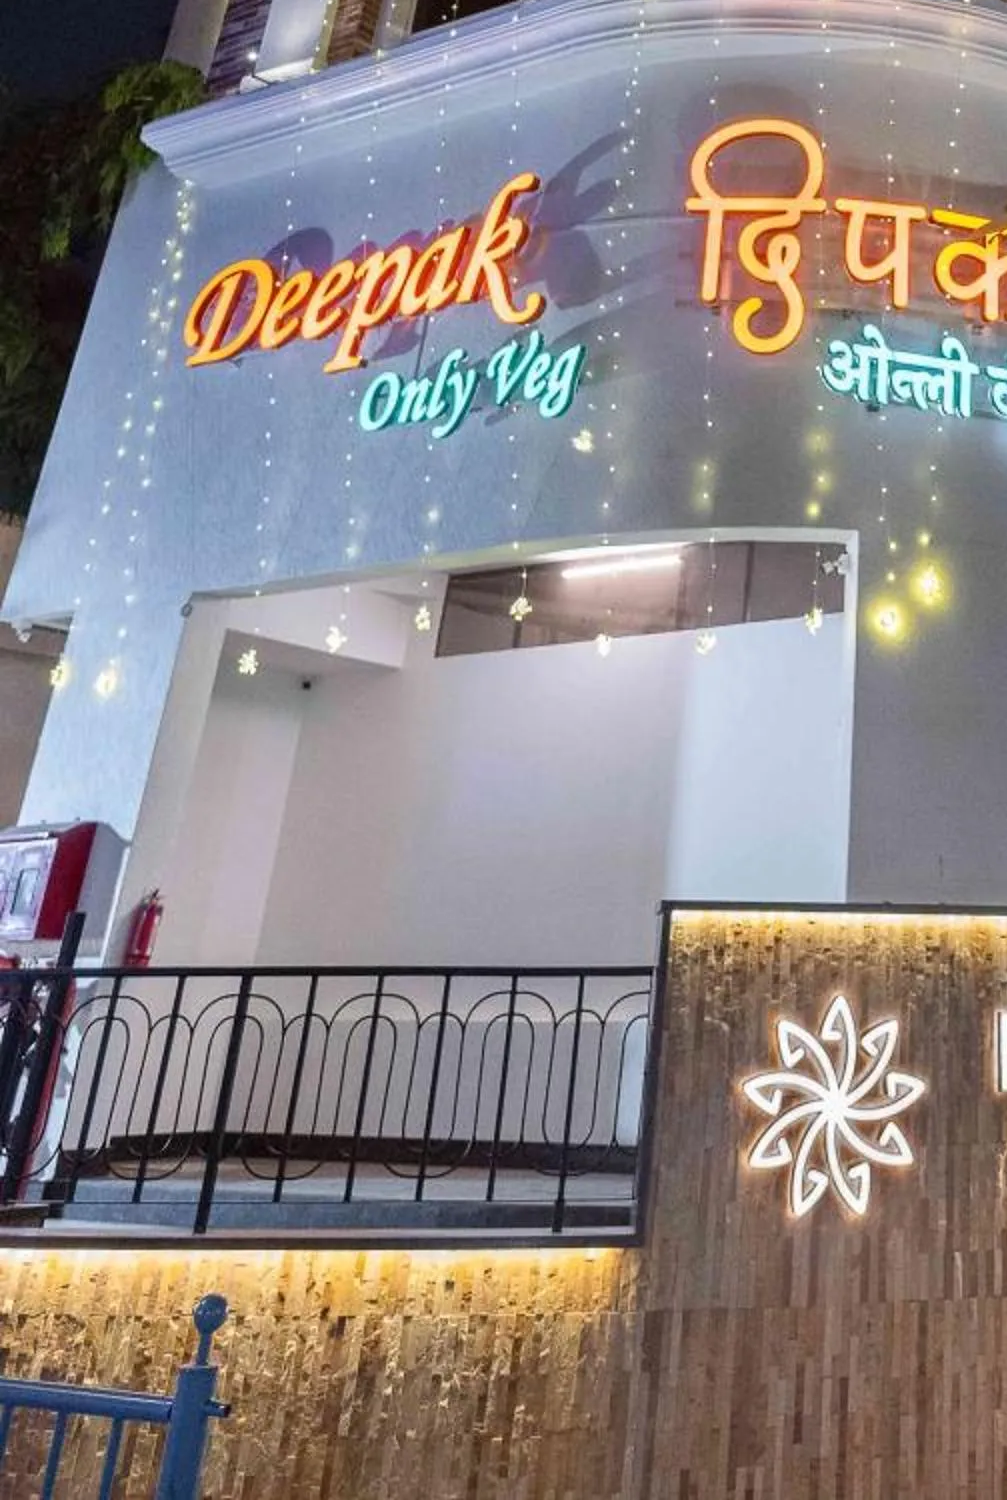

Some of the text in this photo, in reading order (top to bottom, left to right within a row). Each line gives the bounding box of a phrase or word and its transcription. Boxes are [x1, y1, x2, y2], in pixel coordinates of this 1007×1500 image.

[184, 172, 545, 373] Deepak
[359, 330, 586, 438] Only Veg
[821, 324, 980, 418] ओन्ली
